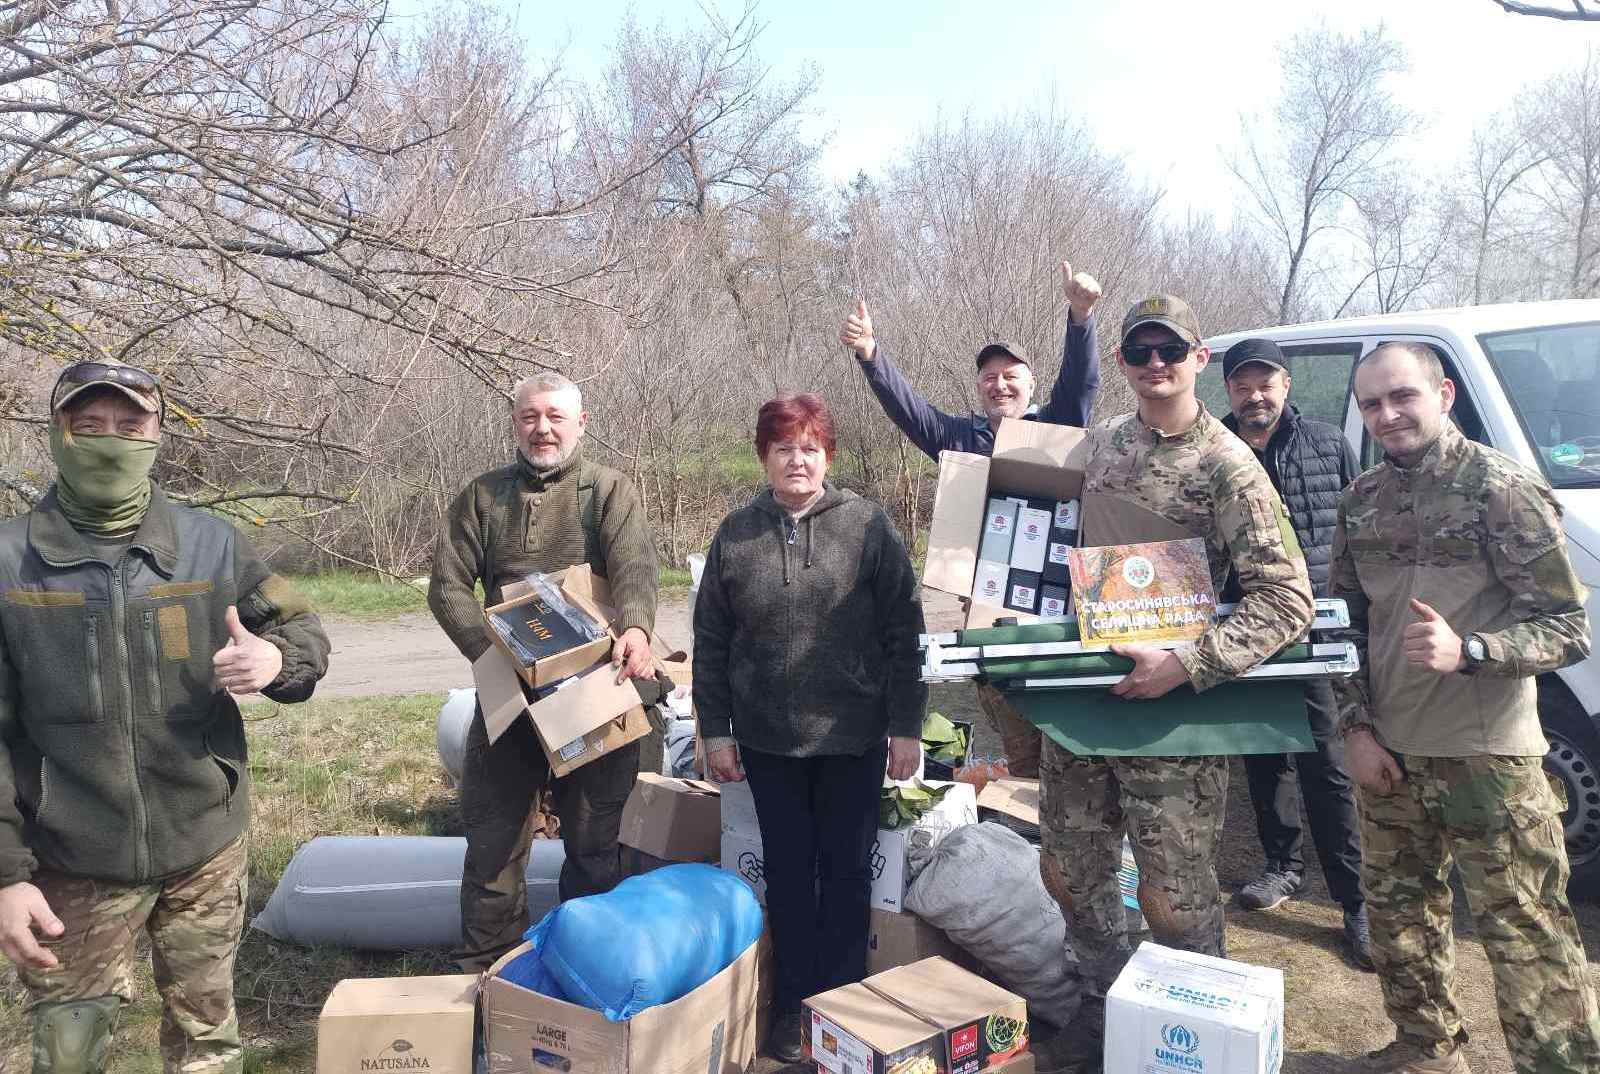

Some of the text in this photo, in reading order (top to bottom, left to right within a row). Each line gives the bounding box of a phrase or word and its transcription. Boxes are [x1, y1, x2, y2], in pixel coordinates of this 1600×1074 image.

[536, 1023, 567, 1042] LARGE
[955, 1041, 975, 1054] VIFON
[360, 1056, 430, 1070] NATUSANA
[1155, 1048, 1202, 1069] UNHCR
